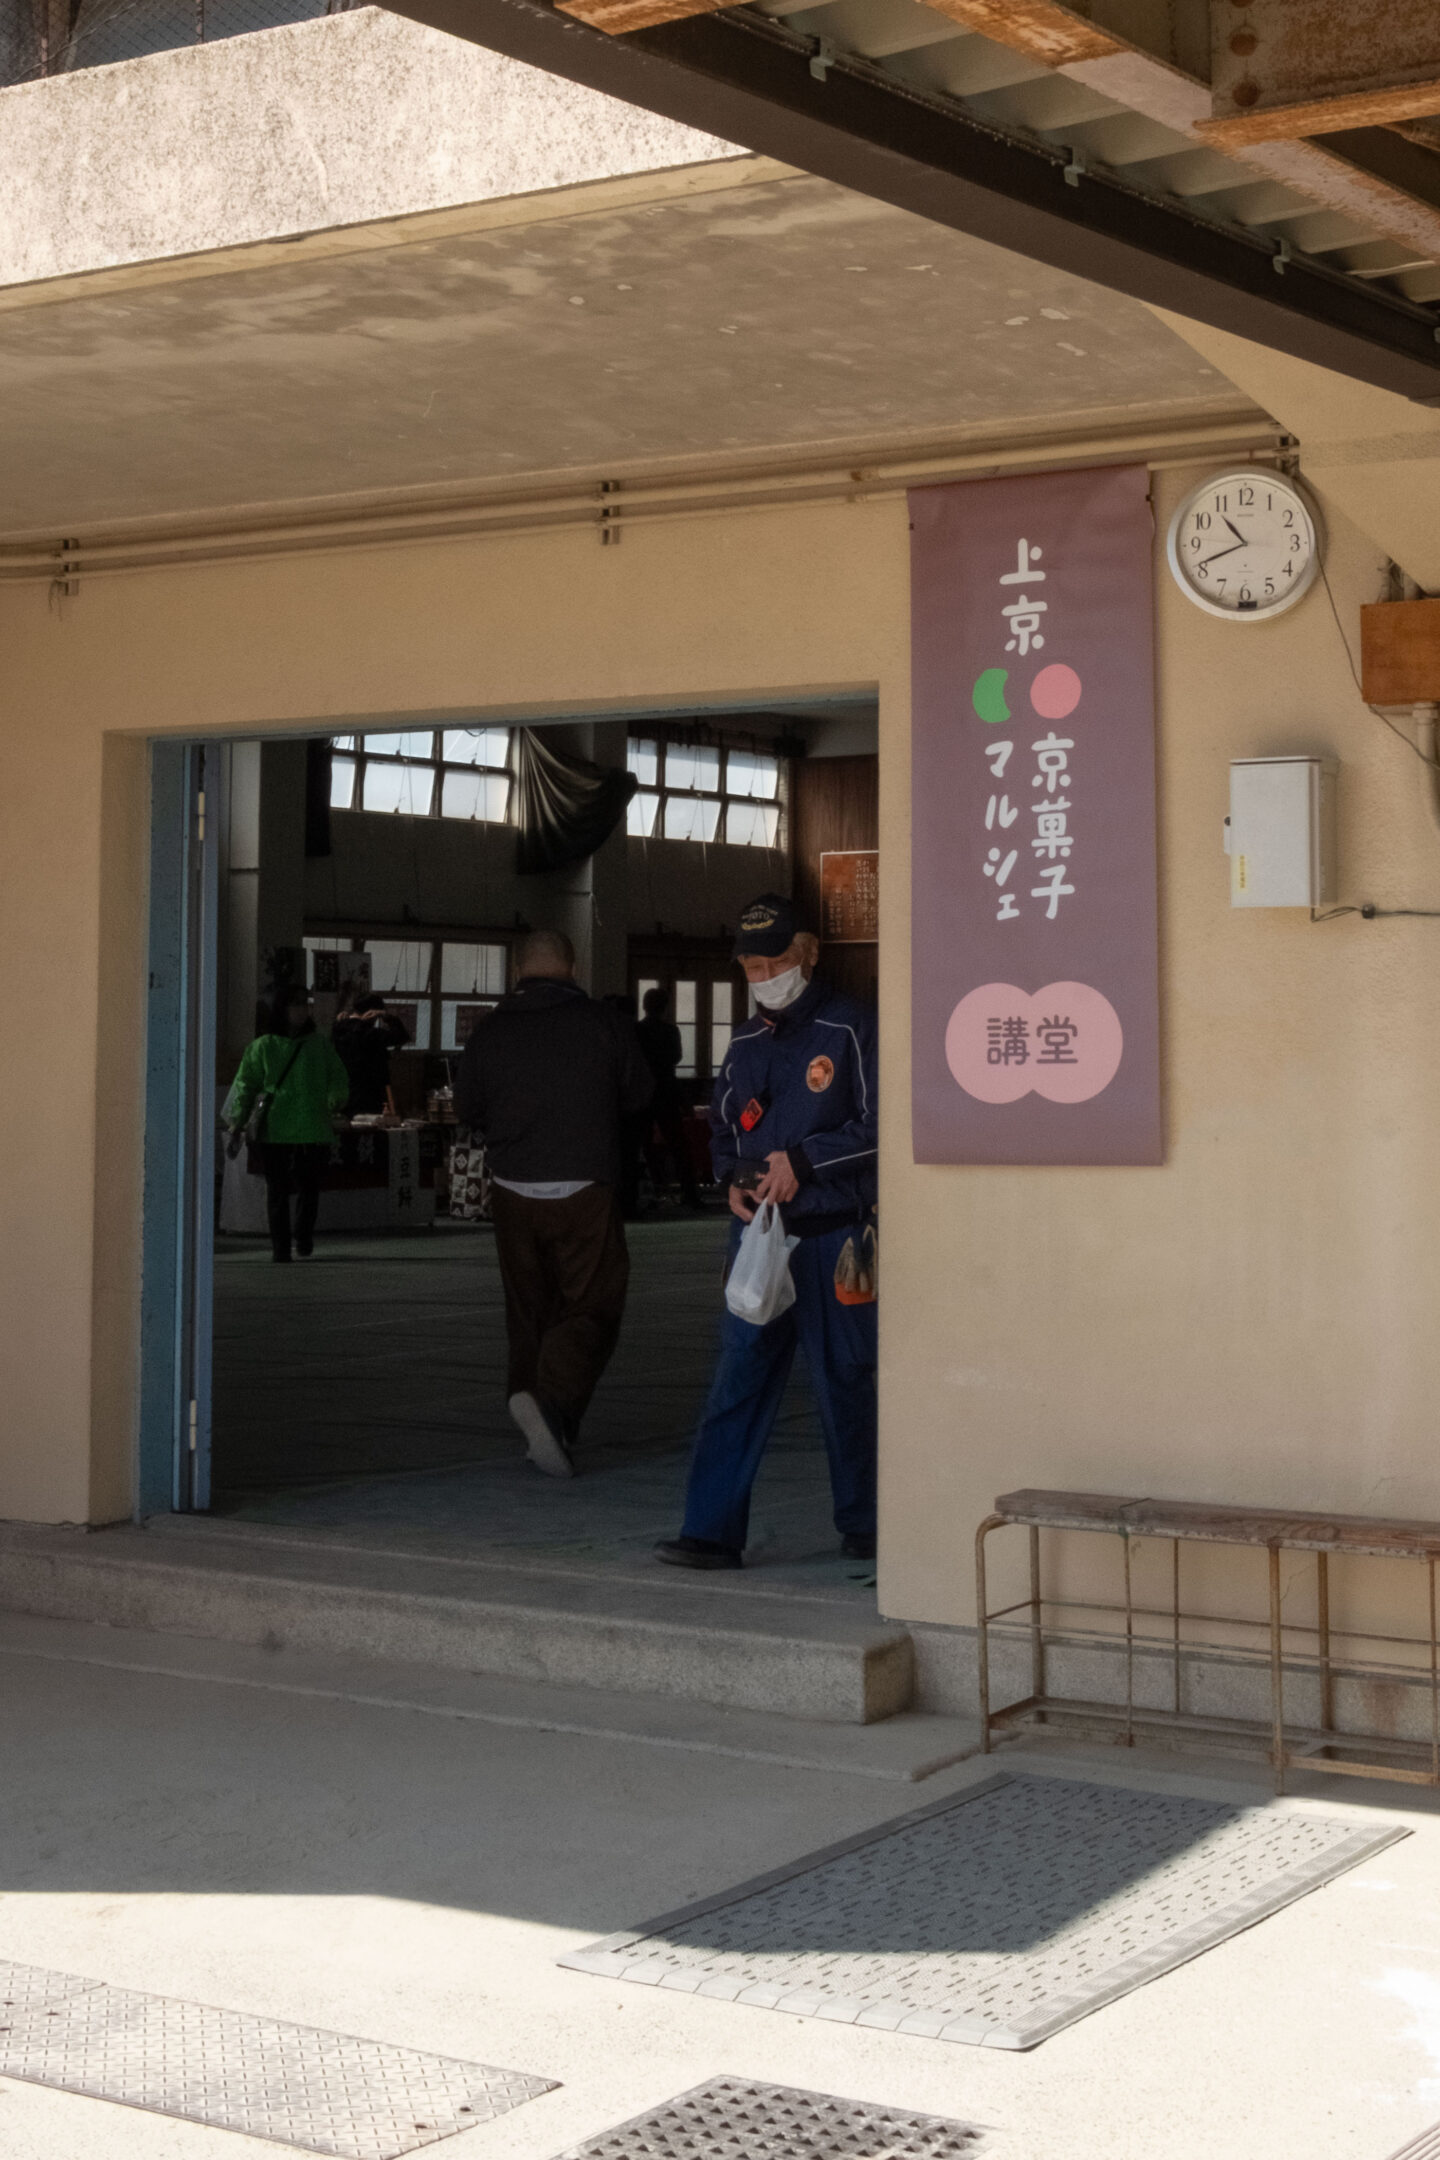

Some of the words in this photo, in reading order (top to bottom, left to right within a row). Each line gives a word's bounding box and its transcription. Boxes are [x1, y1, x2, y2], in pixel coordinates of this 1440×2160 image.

[1215, 495, 1227, 512] 11
[1239, 488, 1254, 505] 12
[1267, 494, 1272, 511] 1
[1195, 512, 1211, 530] 10
[1283, 510, 1293, 527] 2
[1191, 536, 1201, 554] 9
[1290, 534, 1300, 552] 3
[1197, 560, 1208, 579] 8
[1282, 559, 1293, 577] 4
[1217, 579, 1227, 596] 7
[1240, 584, 1251, 601] 6
[1265, 578, 1275, 595] 5
[999, 537, 1048, 656] 上京
[984, 740, 1020, 921] マルシェ
[1031, 731, 1076, 920] 京菓子
[986, 1014, 1078, 1066] 講堂
